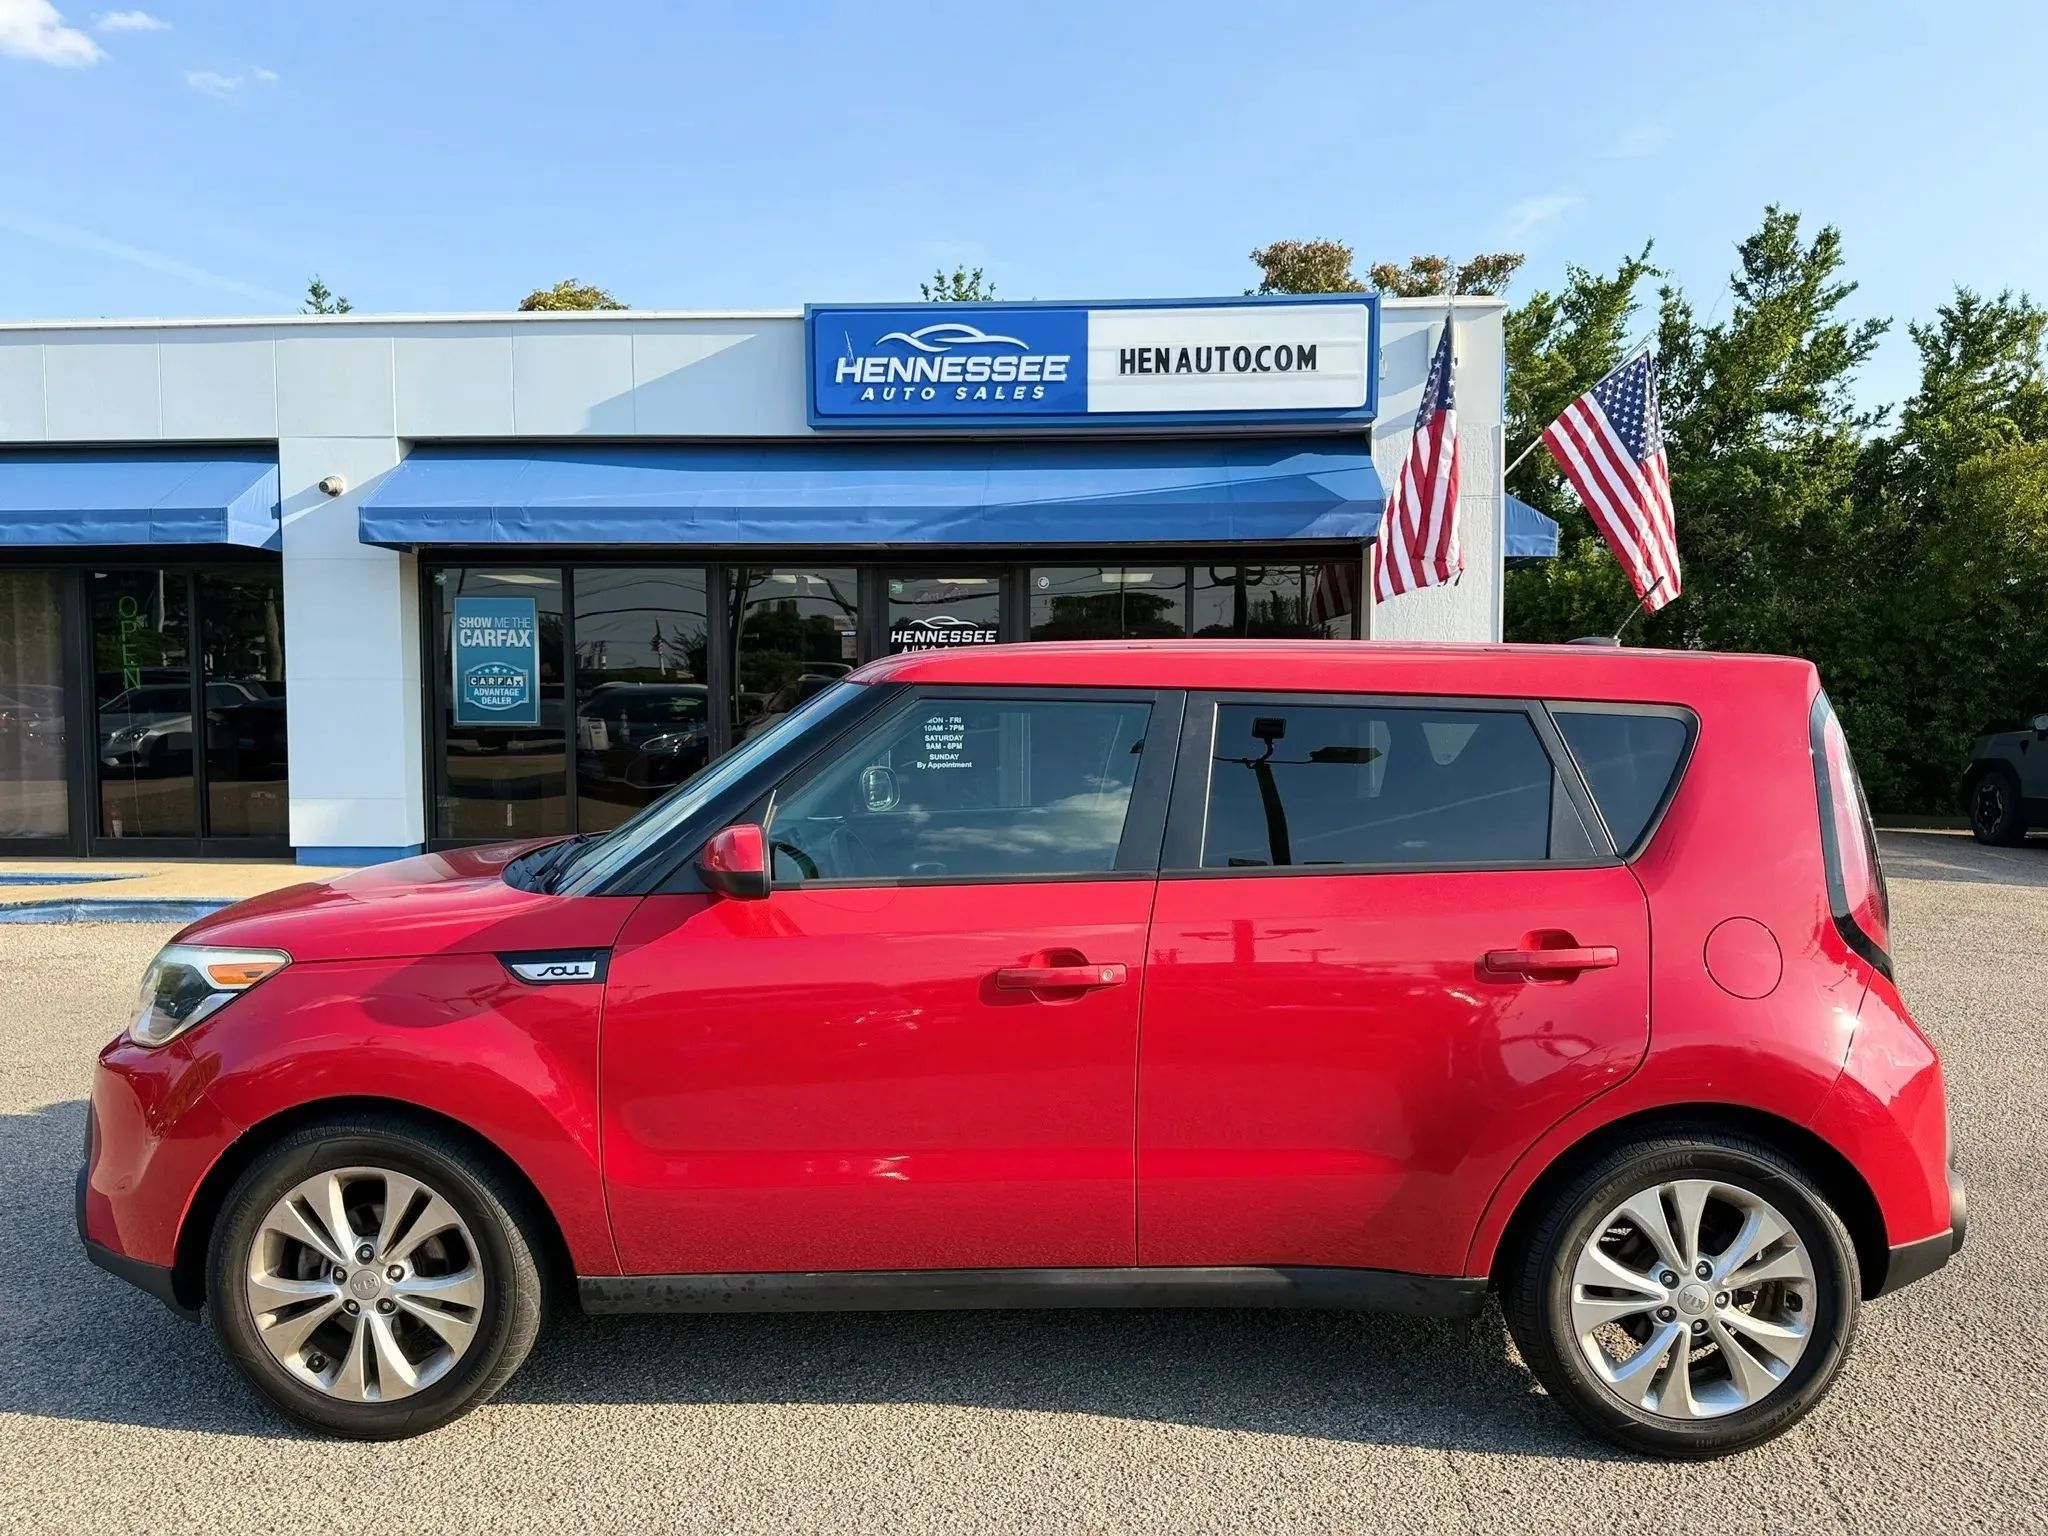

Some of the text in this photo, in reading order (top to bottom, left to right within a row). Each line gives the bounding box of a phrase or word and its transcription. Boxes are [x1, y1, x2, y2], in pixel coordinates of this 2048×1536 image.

[1120, 344, 1317, 374] HENAUTO.COM
[835, 355, 1070, 383] HENNESSEE
[861, 386, 1044, 401] AUTO SALES
[459, 617, 531, 628] SHOW ME THE
[118, 595, 141, 690] OPEN
[460, 629, 531, 648] CARFAX
[891, 631, 996, 643] HENNESSEE
[474, 688, 519, 696] ADVANTAGE
[481, 697, 512, 705] DEALER
[917, 761, 972, 769] By Appointment
[537, 966, 589, 976] SOUL
